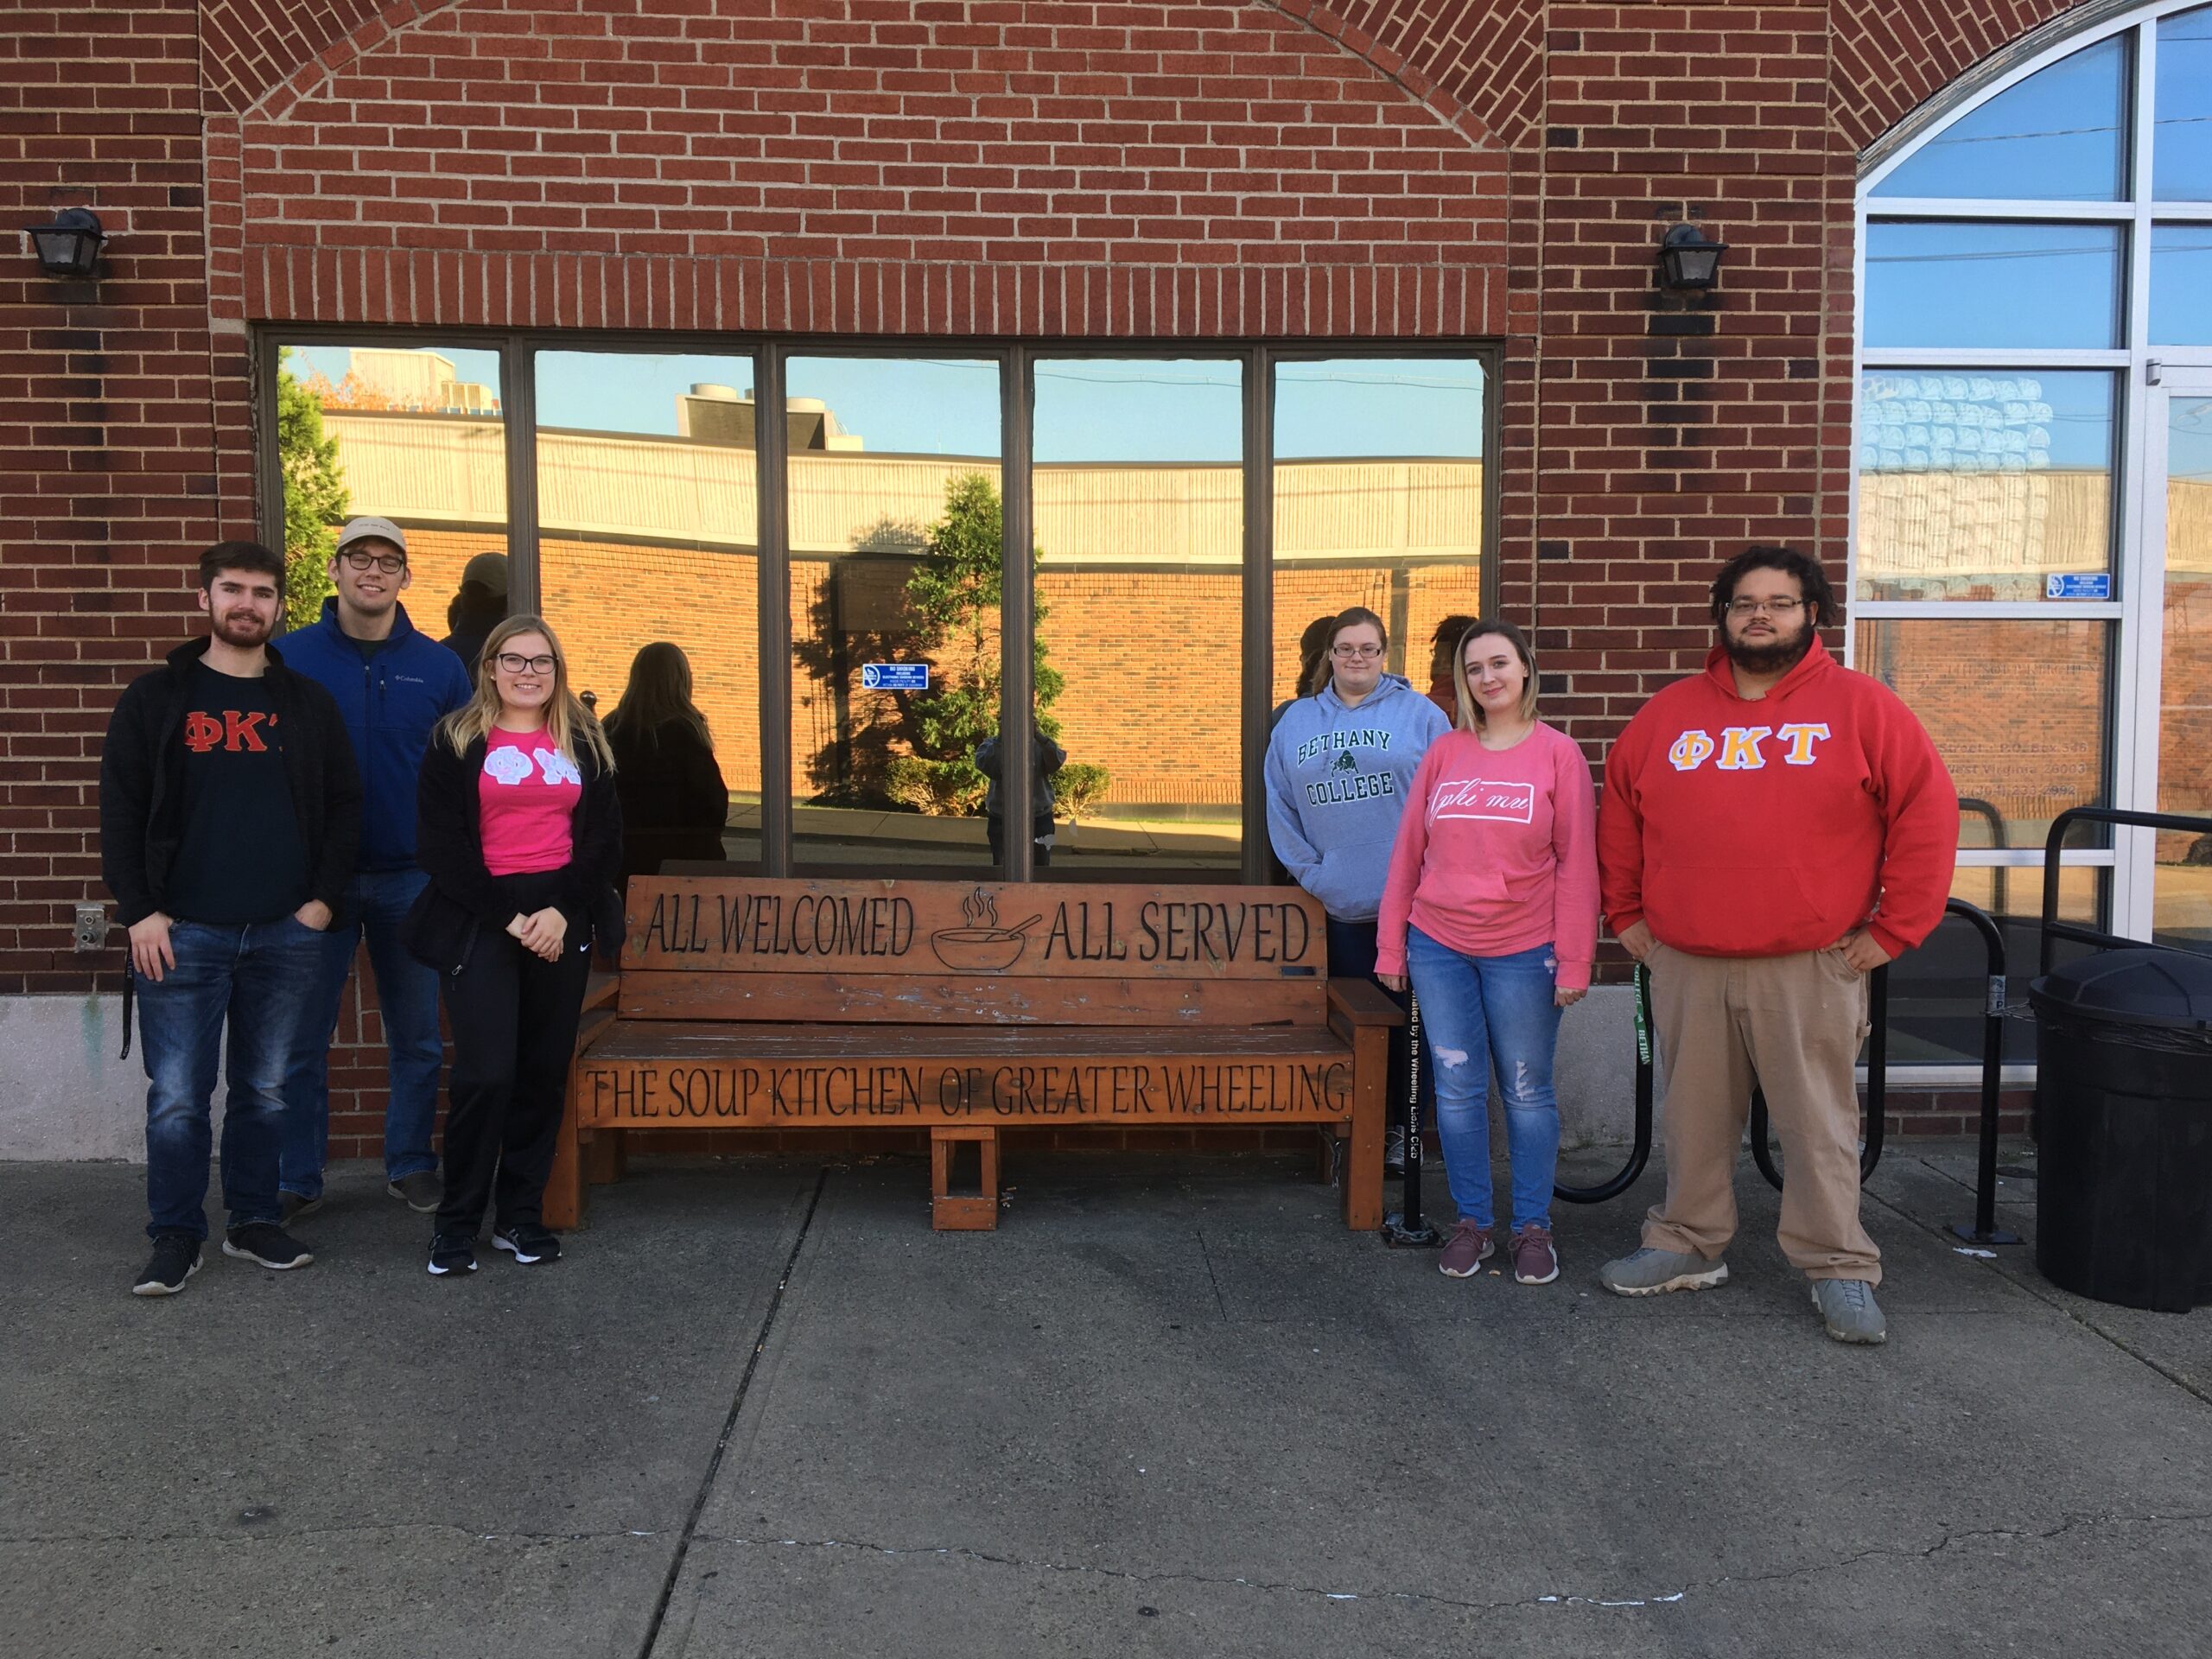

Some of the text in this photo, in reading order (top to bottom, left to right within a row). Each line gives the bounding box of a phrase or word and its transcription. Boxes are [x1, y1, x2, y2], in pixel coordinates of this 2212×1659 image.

[1297, 729, 1391, 767] BETHANY
[1306, 772, 1395, 807] COLLEGE
[1429, 778, 1529, 827] phi mu
[645, 893, 914, 957] ALL WELCOMED
[1044, 900, 1310, 963] ALL SERVED
[1410, 1025, 1420, 1038] by
[1411, 1039, 1420, 1056] the
[585, 1062, 1347, 1118] THE SOUP KITCHEN OF GREATER WHEELING
[1409, 1058, 1420, 1103] Wheeling
